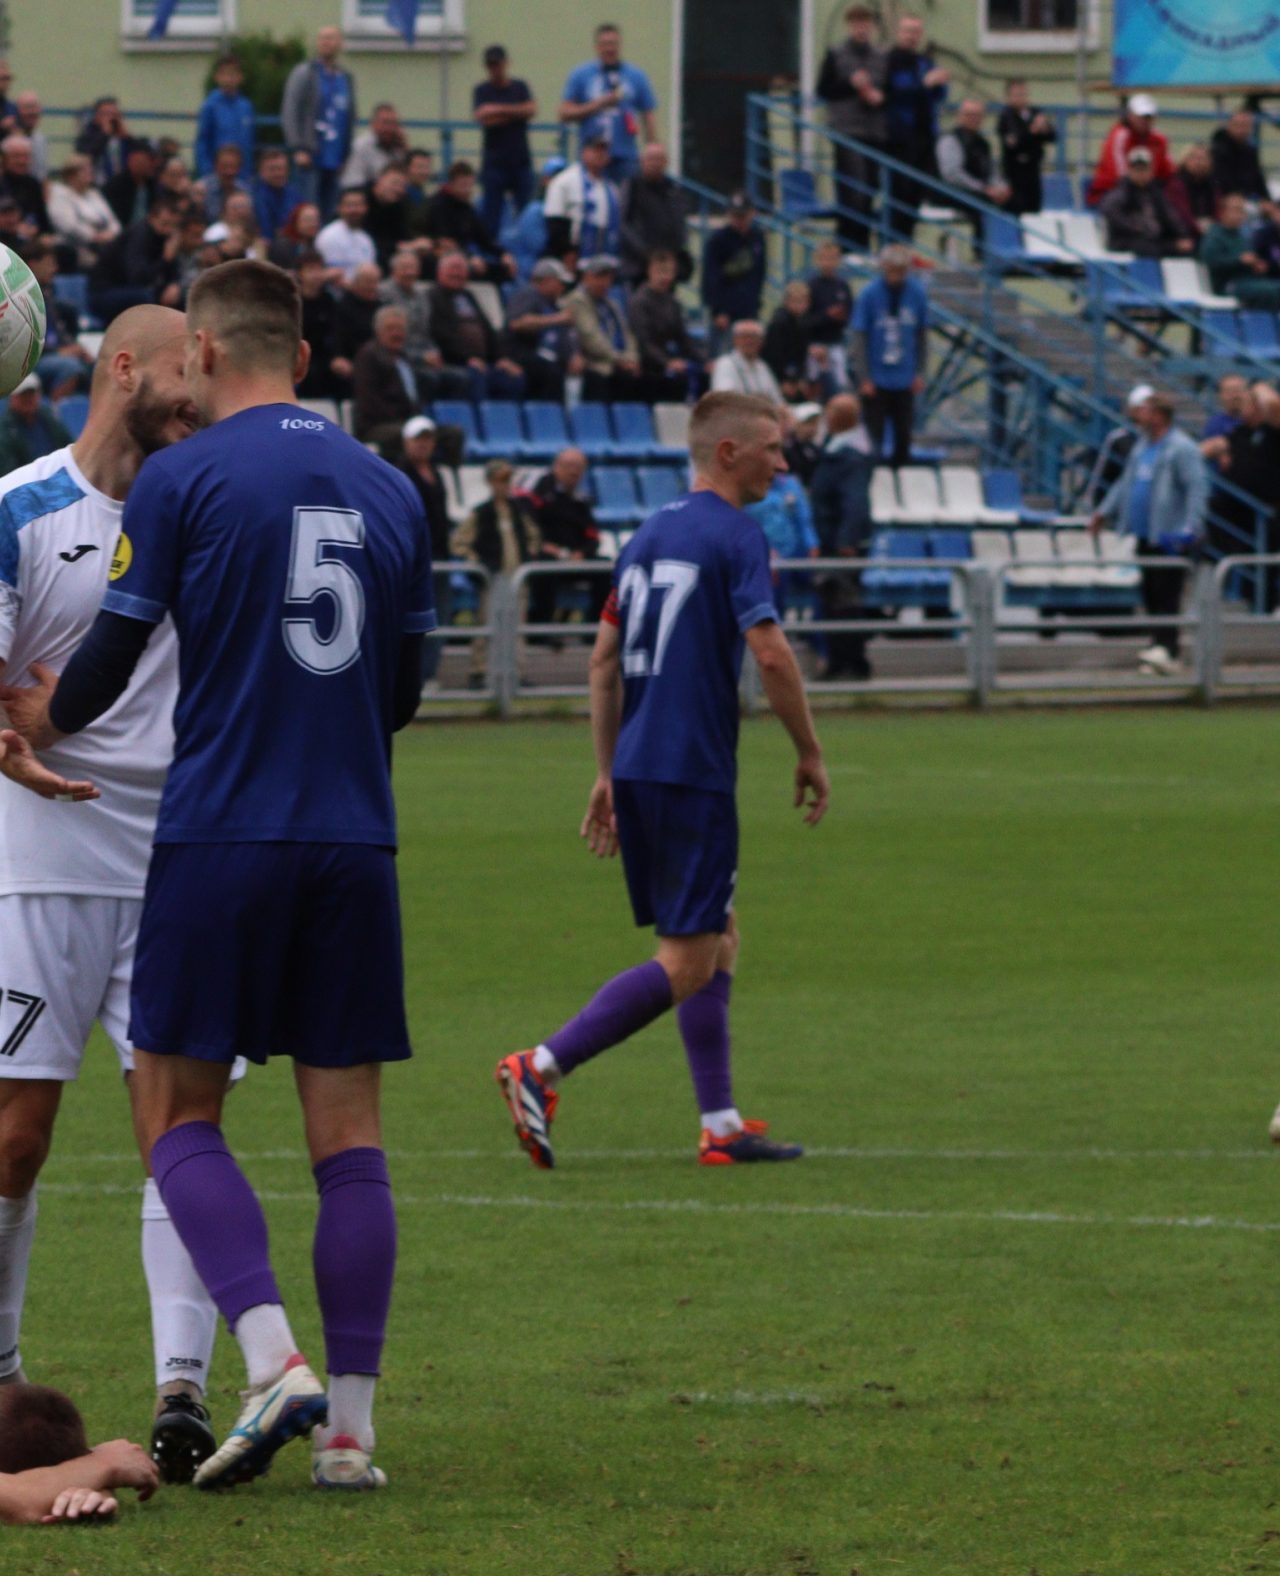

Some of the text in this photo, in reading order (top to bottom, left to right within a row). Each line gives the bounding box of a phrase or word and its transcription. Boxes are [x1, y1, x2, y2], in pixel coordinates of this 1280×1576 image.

[279, 418, 325, 431] 1005
[282, 505, 366, 676] 5
[618, 559, 700, 678] 27
